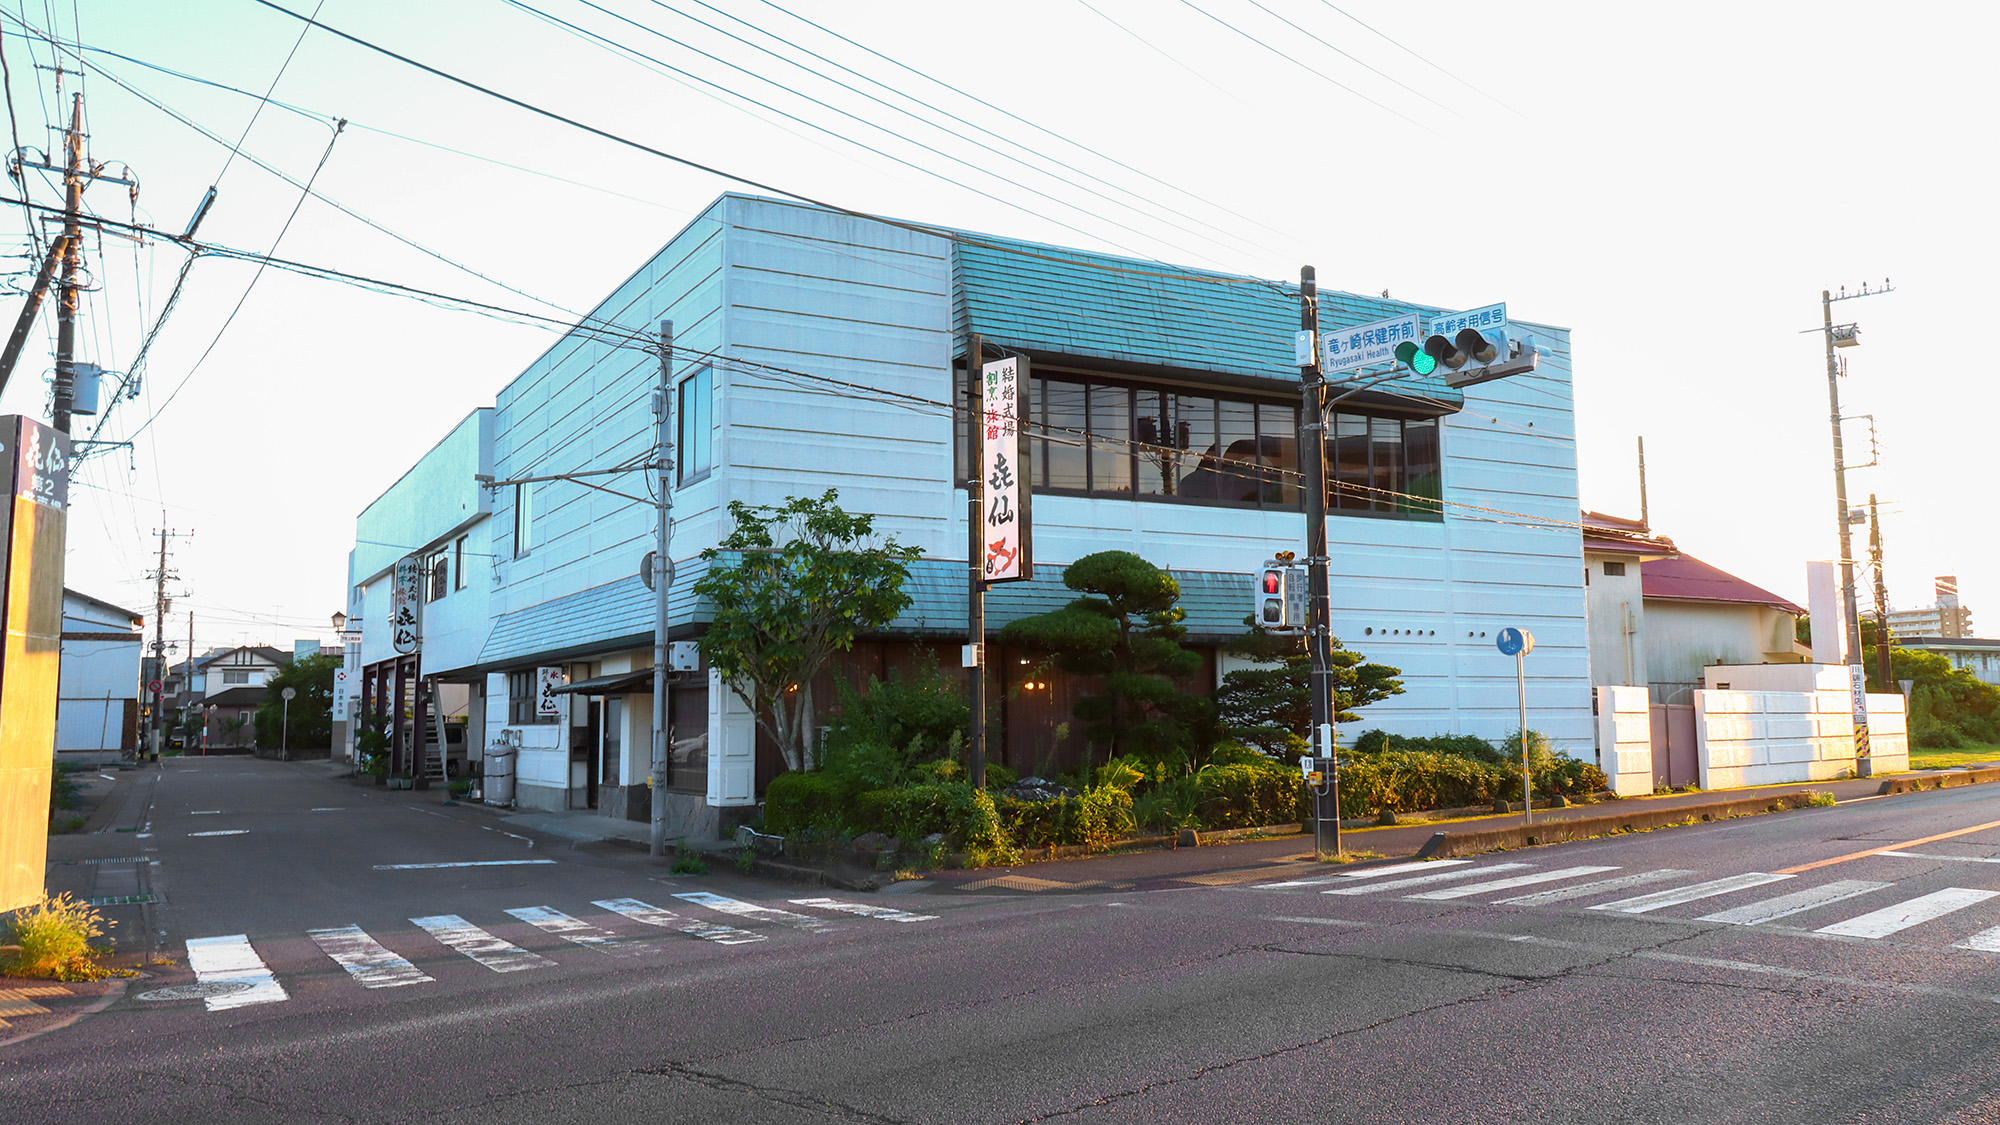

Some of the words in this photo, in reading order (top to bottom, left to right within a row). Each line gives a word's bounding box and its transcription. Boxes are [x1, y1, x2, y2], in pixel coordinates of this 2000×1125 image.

[1434, 308, 1503, 335] 高齢者用信号
[1330, 351, 1365, 368] Ryugasaki
[1366, 345, 1390, 360] Health
[1001, 365, 1015, 438] 結婚式場
